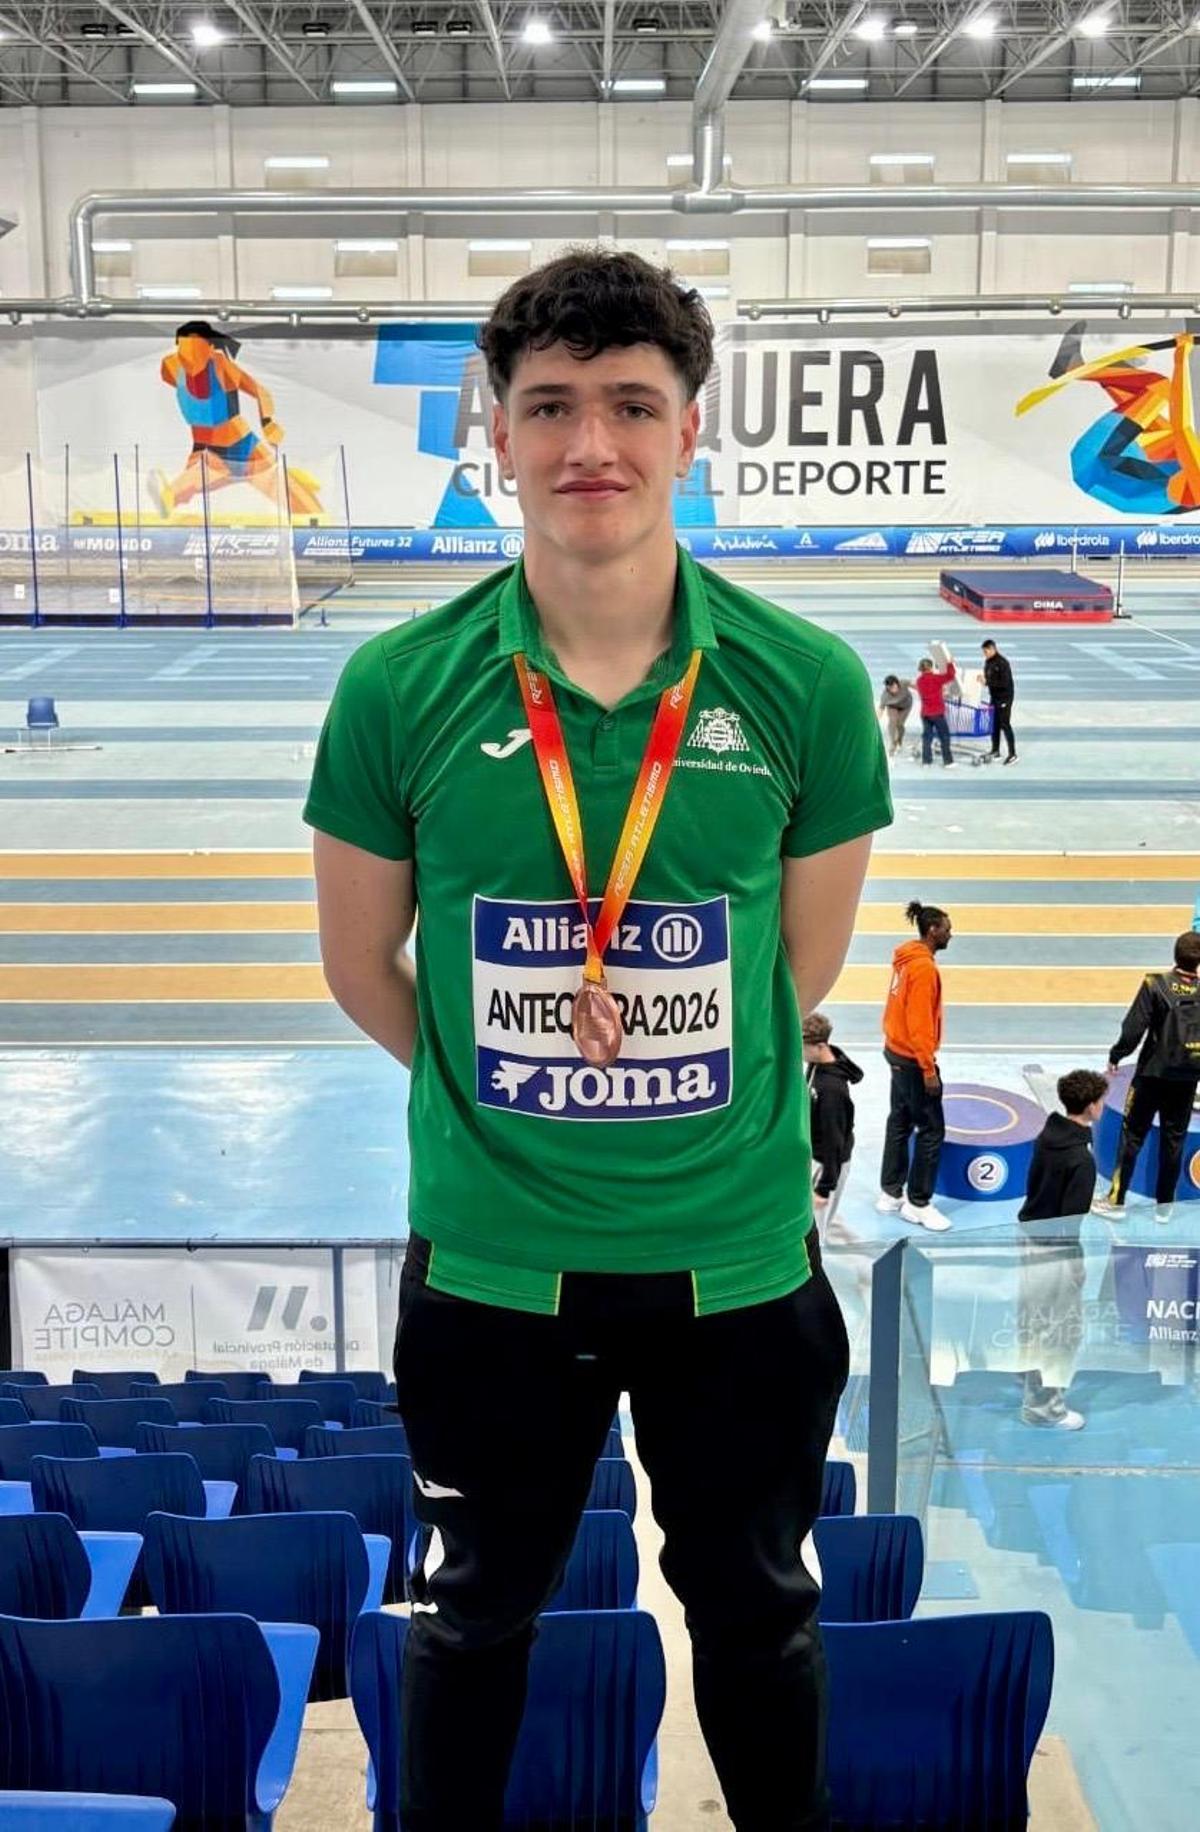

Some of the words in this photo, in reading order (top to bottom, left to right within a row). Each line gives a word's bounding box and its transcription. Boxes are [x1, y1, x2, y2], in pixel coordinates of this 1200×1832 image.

[737, 461, 947, 496] DEPORTE
[307, 536, 349, 547] Allianz
[352, 536, 394, 548] Futures
[431, 536, 497, 554] Allianz
[1057, 534, 1109, 546] Iberdrola
[672, 757, 723, 770] niversidad
[725, 761, 738, 771] de
[979, 1162, 994, 1180] 2
